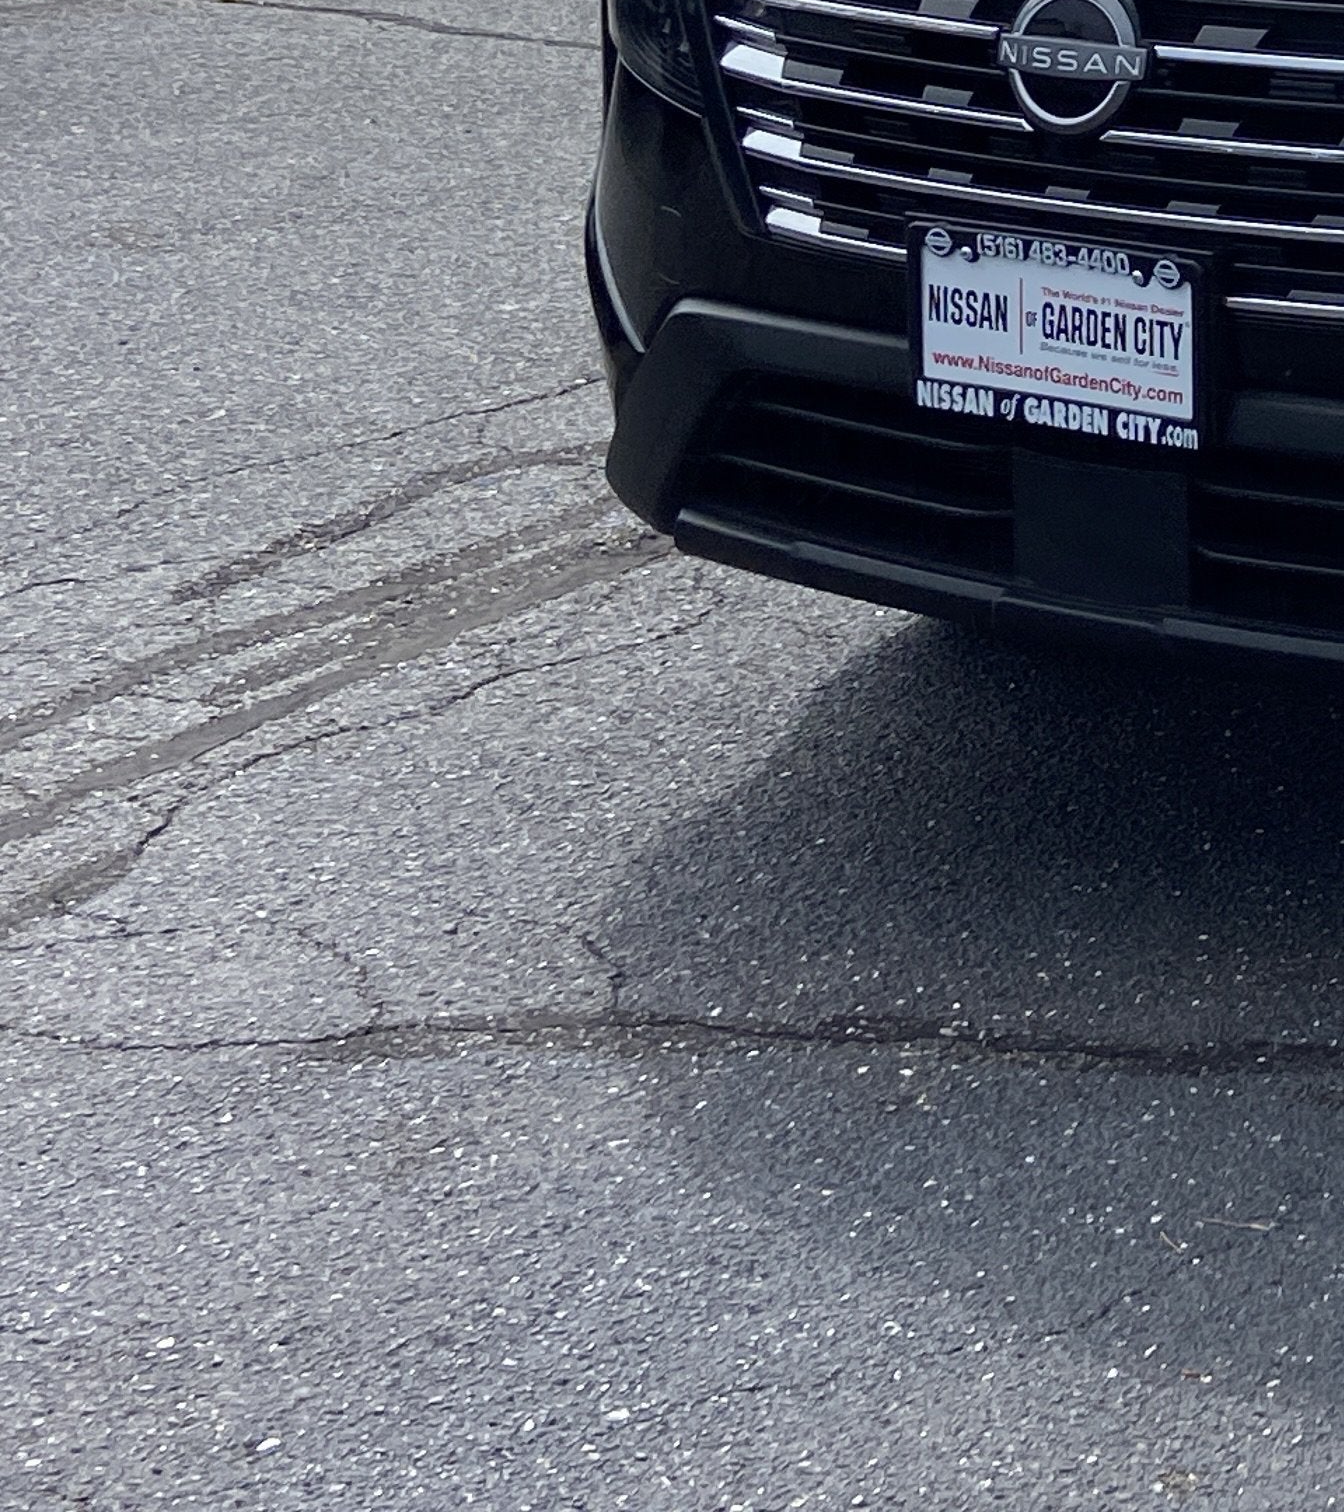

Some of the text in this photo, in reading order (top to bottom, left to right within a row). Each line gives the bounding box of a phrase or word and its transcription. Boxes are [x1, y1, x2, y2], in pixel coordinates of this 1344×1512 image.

[1000, 40, 1140, 76] NISSAN
[977, 233, 1130, 275] (516) 483-4400
[928, 284, 1008, 332] NISSAN
[1025, 302, 1183, 360] OF GARDEN CITY
[933, 352, 1183, 404] www.NissanofGardenCity.com
[917, 380, 1198, 450] NISSAN of GARDEN CITY.com
